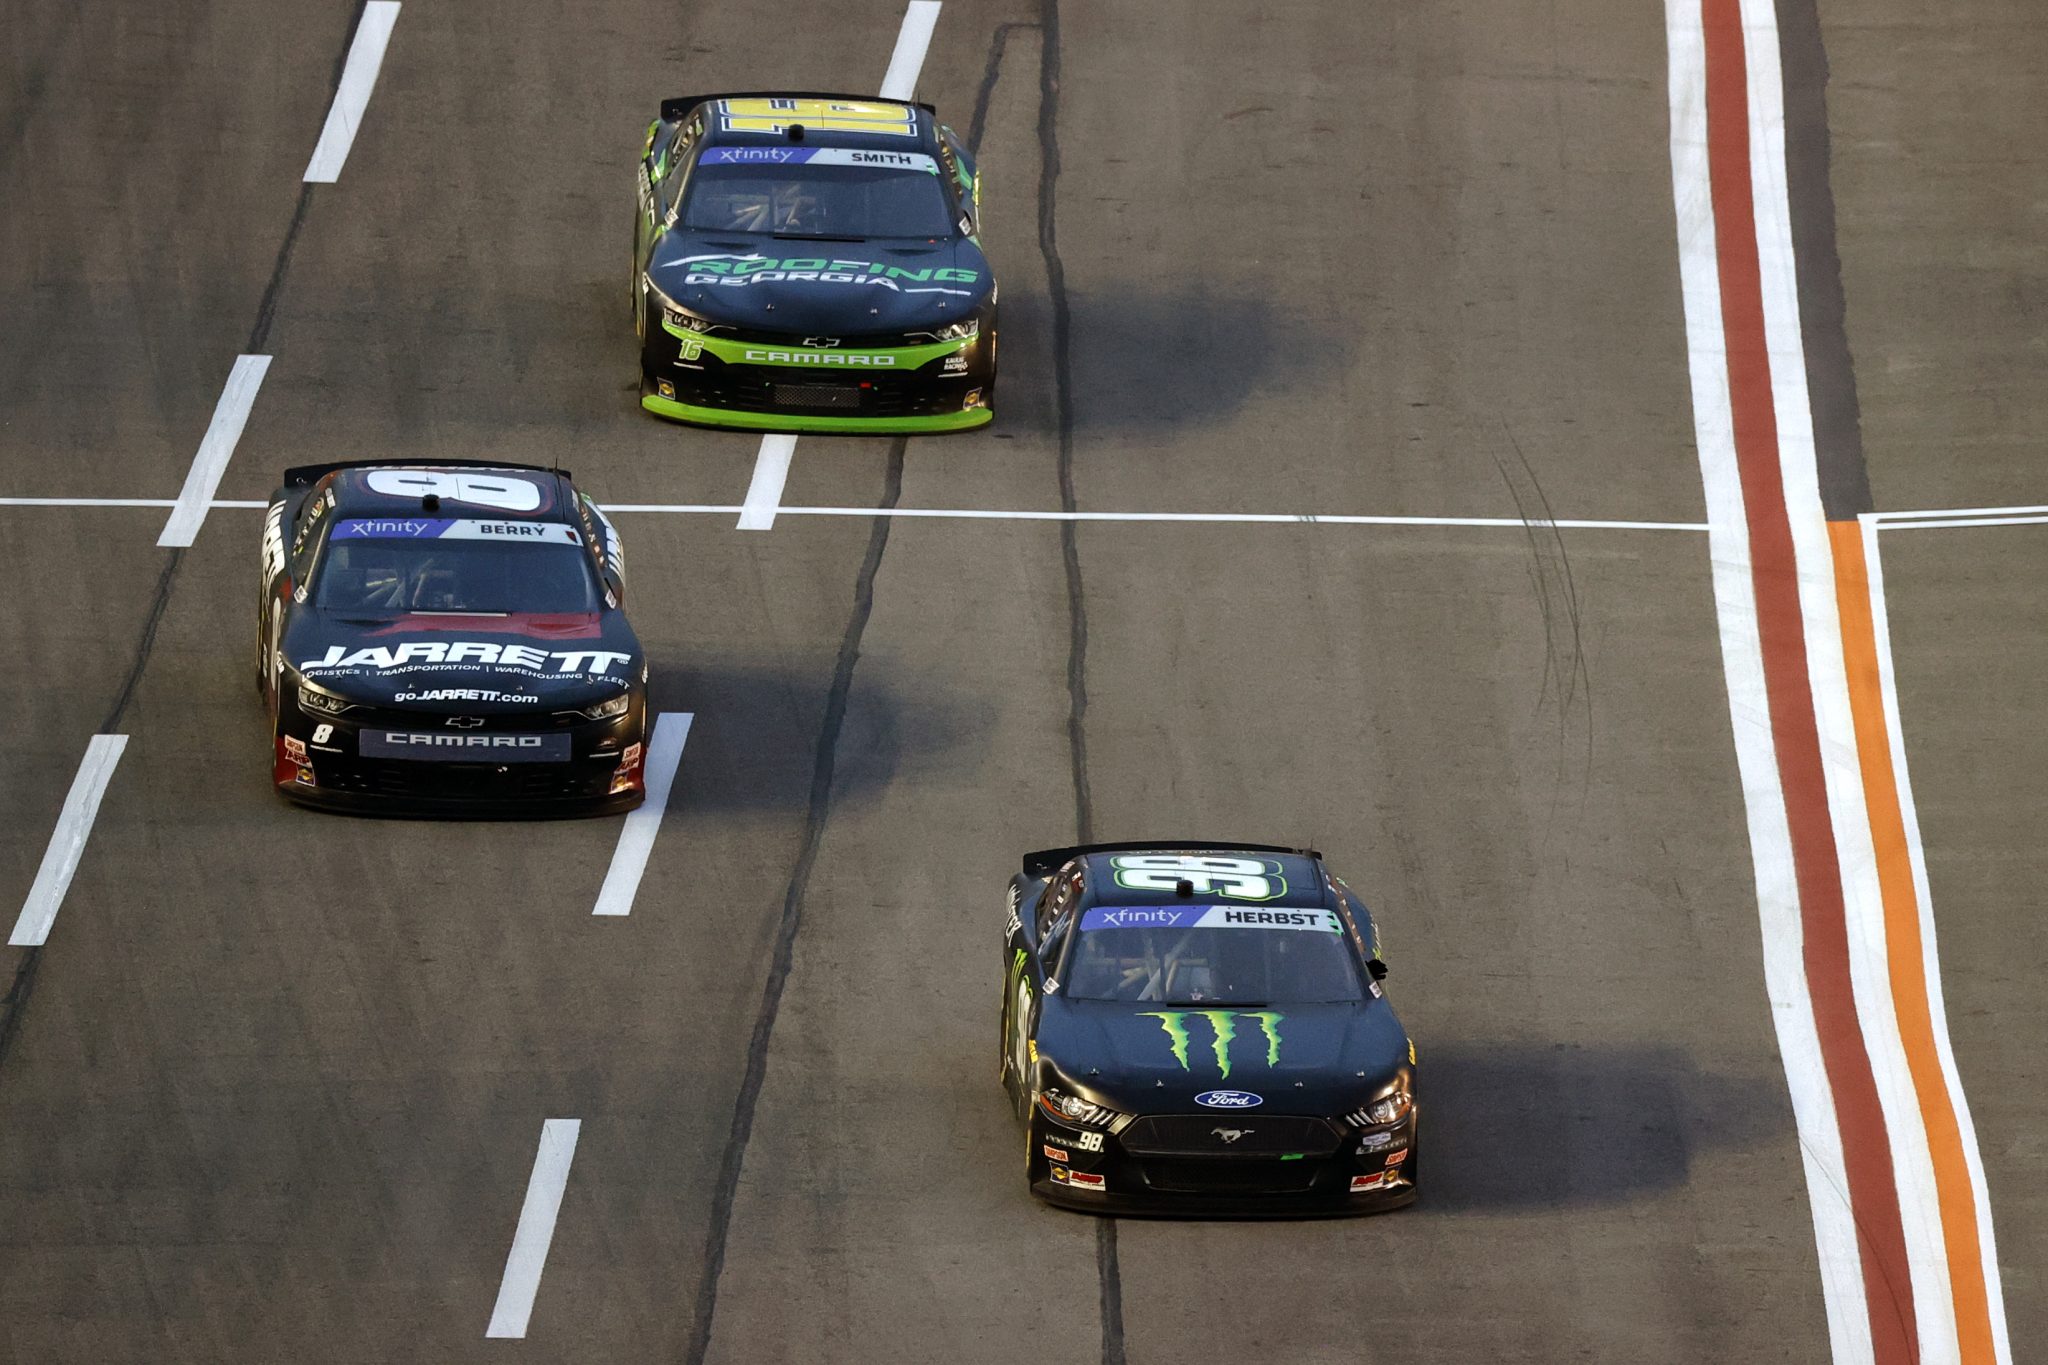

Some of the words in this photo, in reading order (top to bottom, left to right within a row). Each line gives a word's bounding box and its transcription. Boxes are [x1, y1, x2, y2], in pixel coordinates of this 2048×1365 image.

[720, 147, 794, 164] xfinity
[851, 151, 912, 165] SMITH
[688, 258, 979, 283] ROOFING
[684, 270, 900, 292] GEORGIA
[679, 338, 704, 360] 16
[745, 350, 895, 366] CAMARO
[352, 519, 428, 537] xfinity
[480, 523, 546, 537] BERRY
[300, 641, 632, 674] JARRETT
[301, 668, 361, 683] LOGISTICS
[375, 664, 481, 677] TRANSPORTATION
[494, 666, 584, 680] WAREHOUSING
[596, 675, 631, 691] FLEET
[394, 688, 539, 704] goJARRETT.com
[311, 724, 334, 743] 8
[385, 732, 542, 748] CAMARO
[1103, 909, 1183, 927] xfinity
[1225, 911, 1320, 927] HERBST
[1207, 1091, 1250, 1107] Ford
[1079, 1131, 1104, 1152] 98
